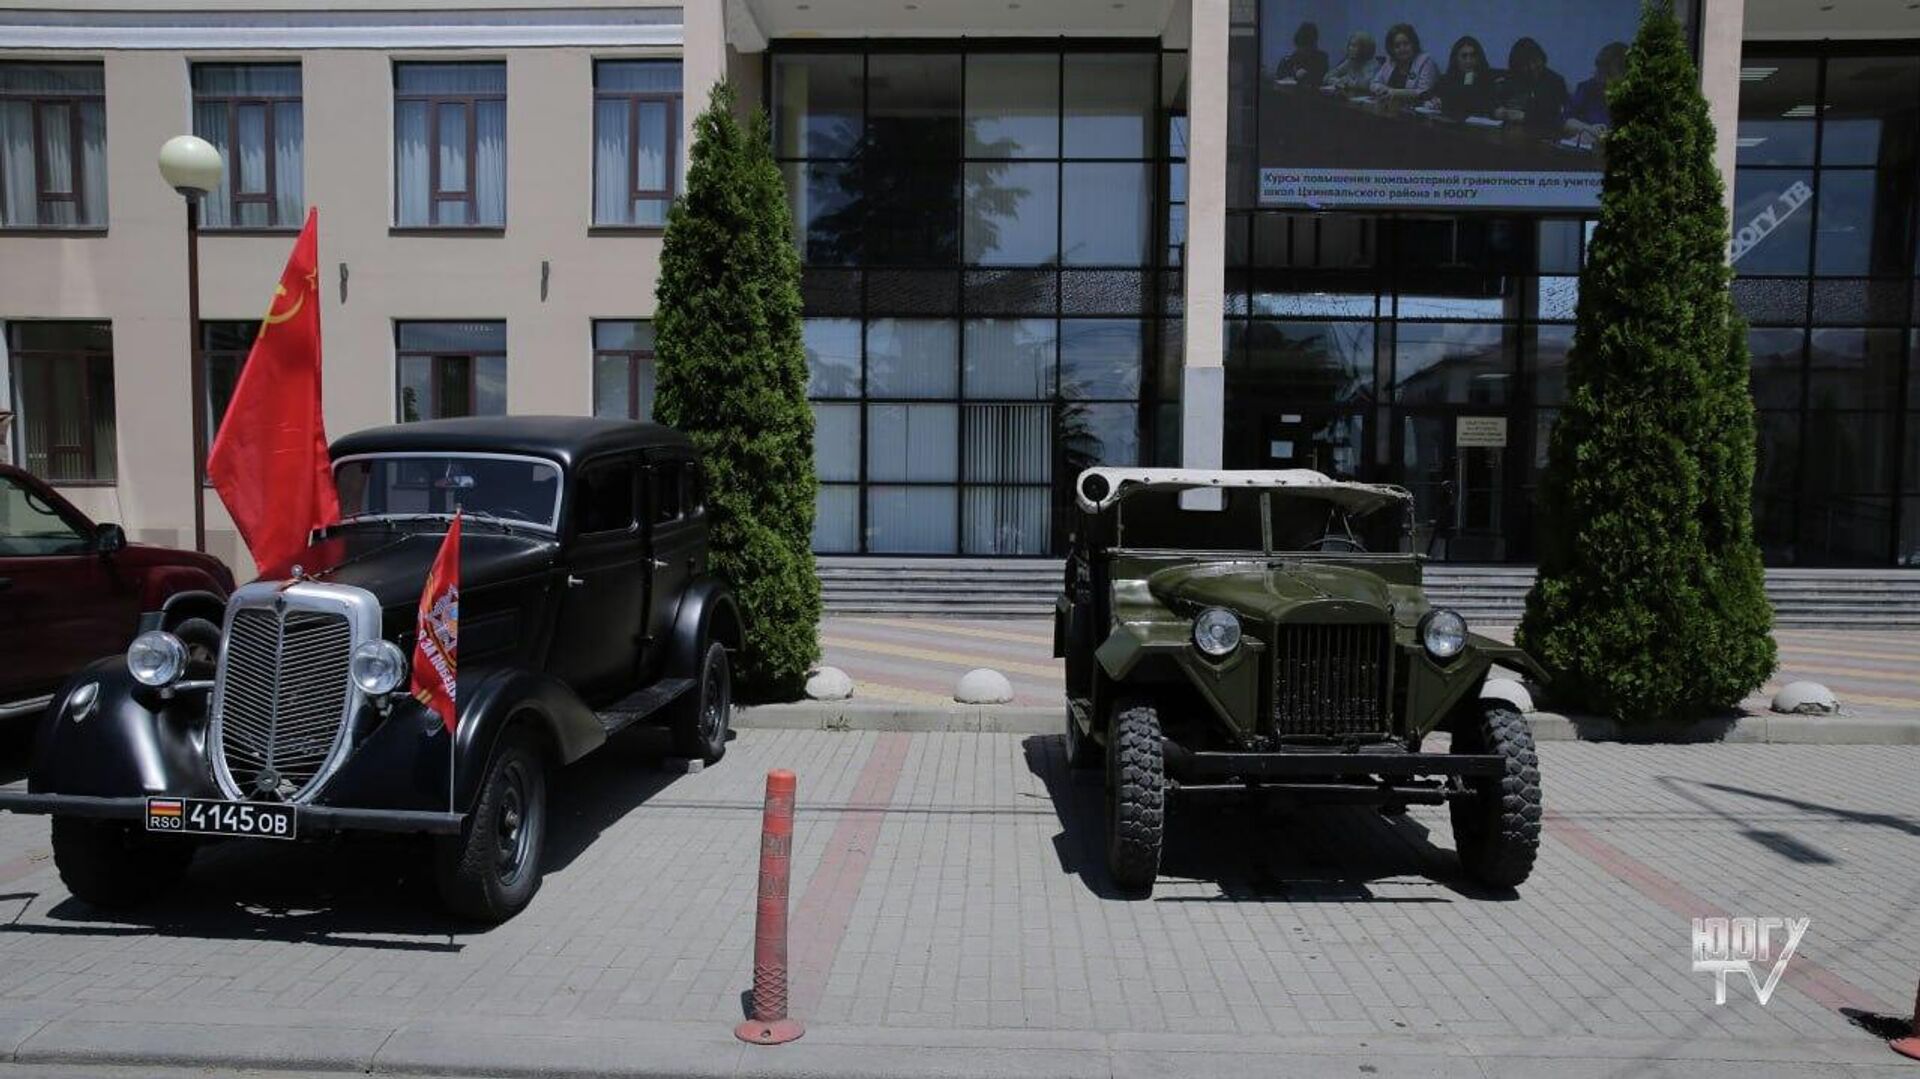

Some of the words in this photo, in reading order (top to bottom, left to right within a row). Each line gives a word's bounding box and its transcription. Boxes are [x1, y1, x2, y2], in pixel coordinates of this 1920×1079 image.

[1264, 172, 1299, 185] Курсы
[1303, 175, 1370, 183] повышения
[1374, 175, 1460, 186] компьютерной
[1463, 177, 1536, 187] грамотности
[1539, 177, 1560, 187] для
[1264, 188, 1294, 196] школ
[1297, 187, 1386, 197] Цхинвальского
[1389, 188, 1430, 200] района
[1433, 190, 1441, 198] в
[1443, 189, 1478, 198] ЮОГУ
[150, 816, 181, 829] RSO
[190, 803, 255, 832] 4145
